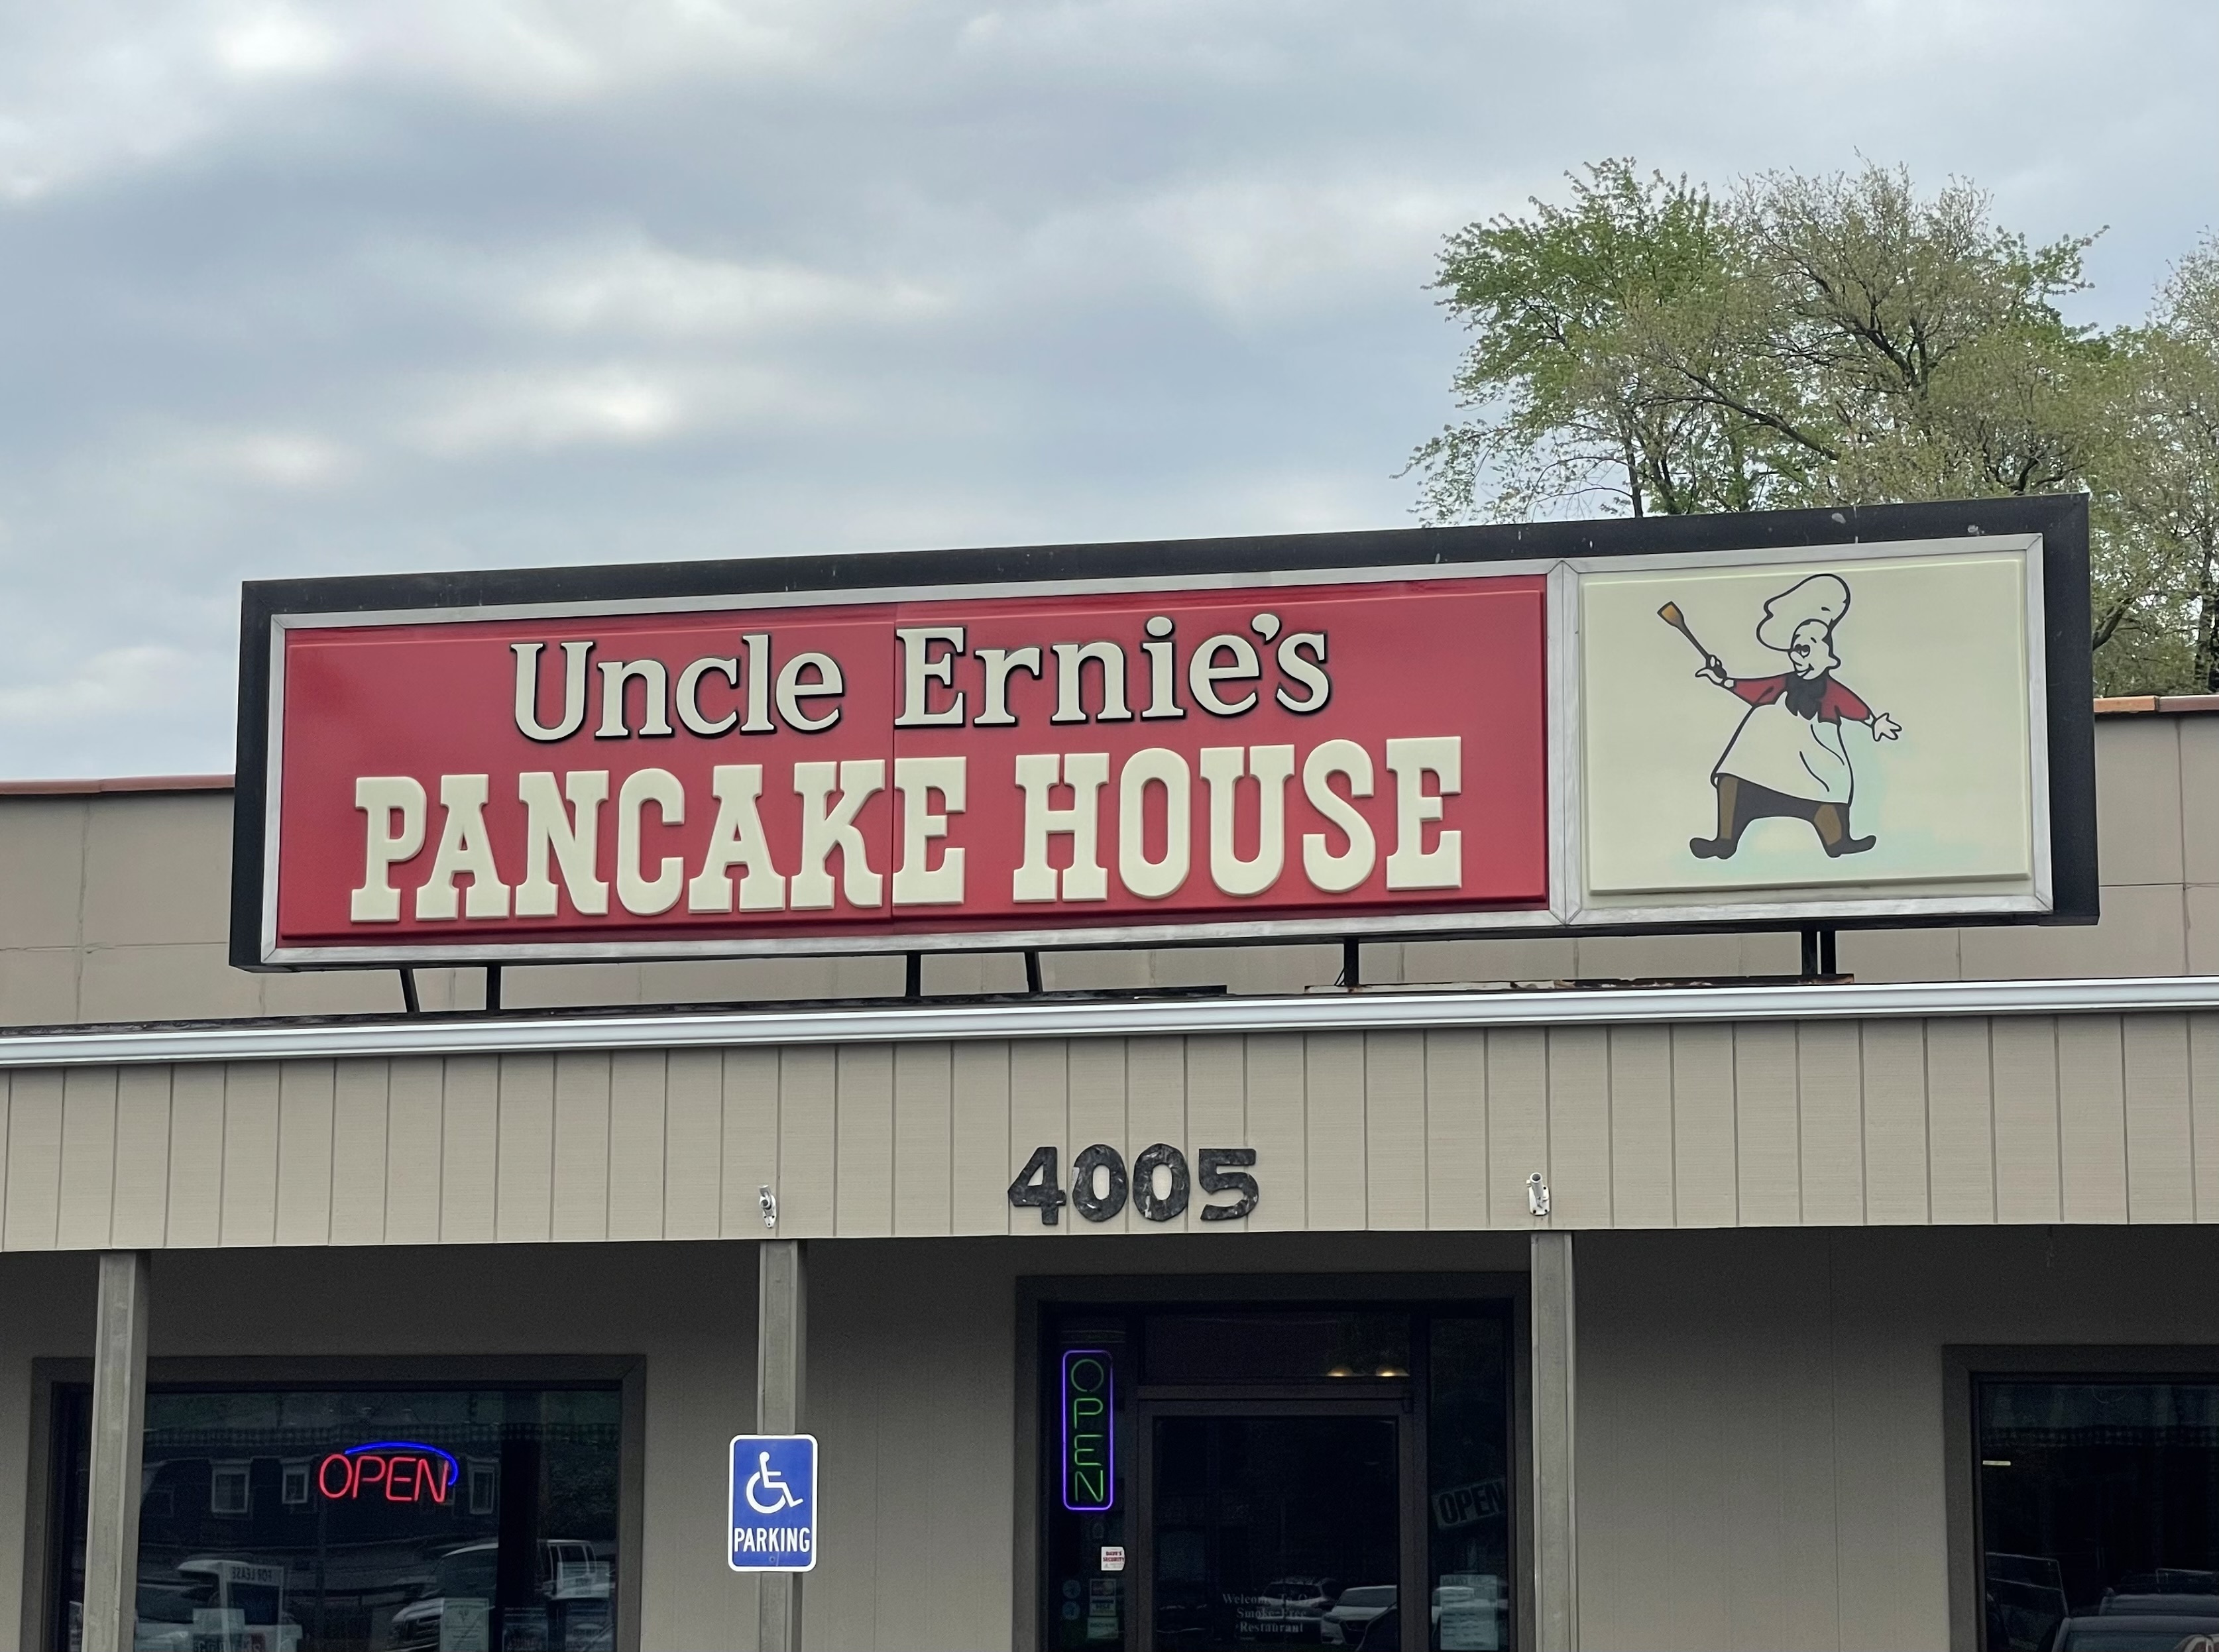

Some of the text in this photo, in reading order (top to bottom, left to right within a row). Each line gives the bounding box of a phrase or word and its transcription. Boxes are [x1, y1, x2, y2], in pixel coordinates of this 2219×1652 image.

[510, 612, 1332, 742] Uncle Ernie's
[351, 736, 1462, 922] PANCAKE HOUSE
[1007, 1143, 1259, 1225] 4005
[1070, 1358, 1104, 1503] OPEN
[319, 1453, 449, 1503] OPEN
[1438, 1482, 1505, 1524] OPEN
[734, 1527, 811, 1553] PARKING
[1222, 1593, 1271, 1604] Welcom
[1240, 1621, 1303, 1633] Restaurant
